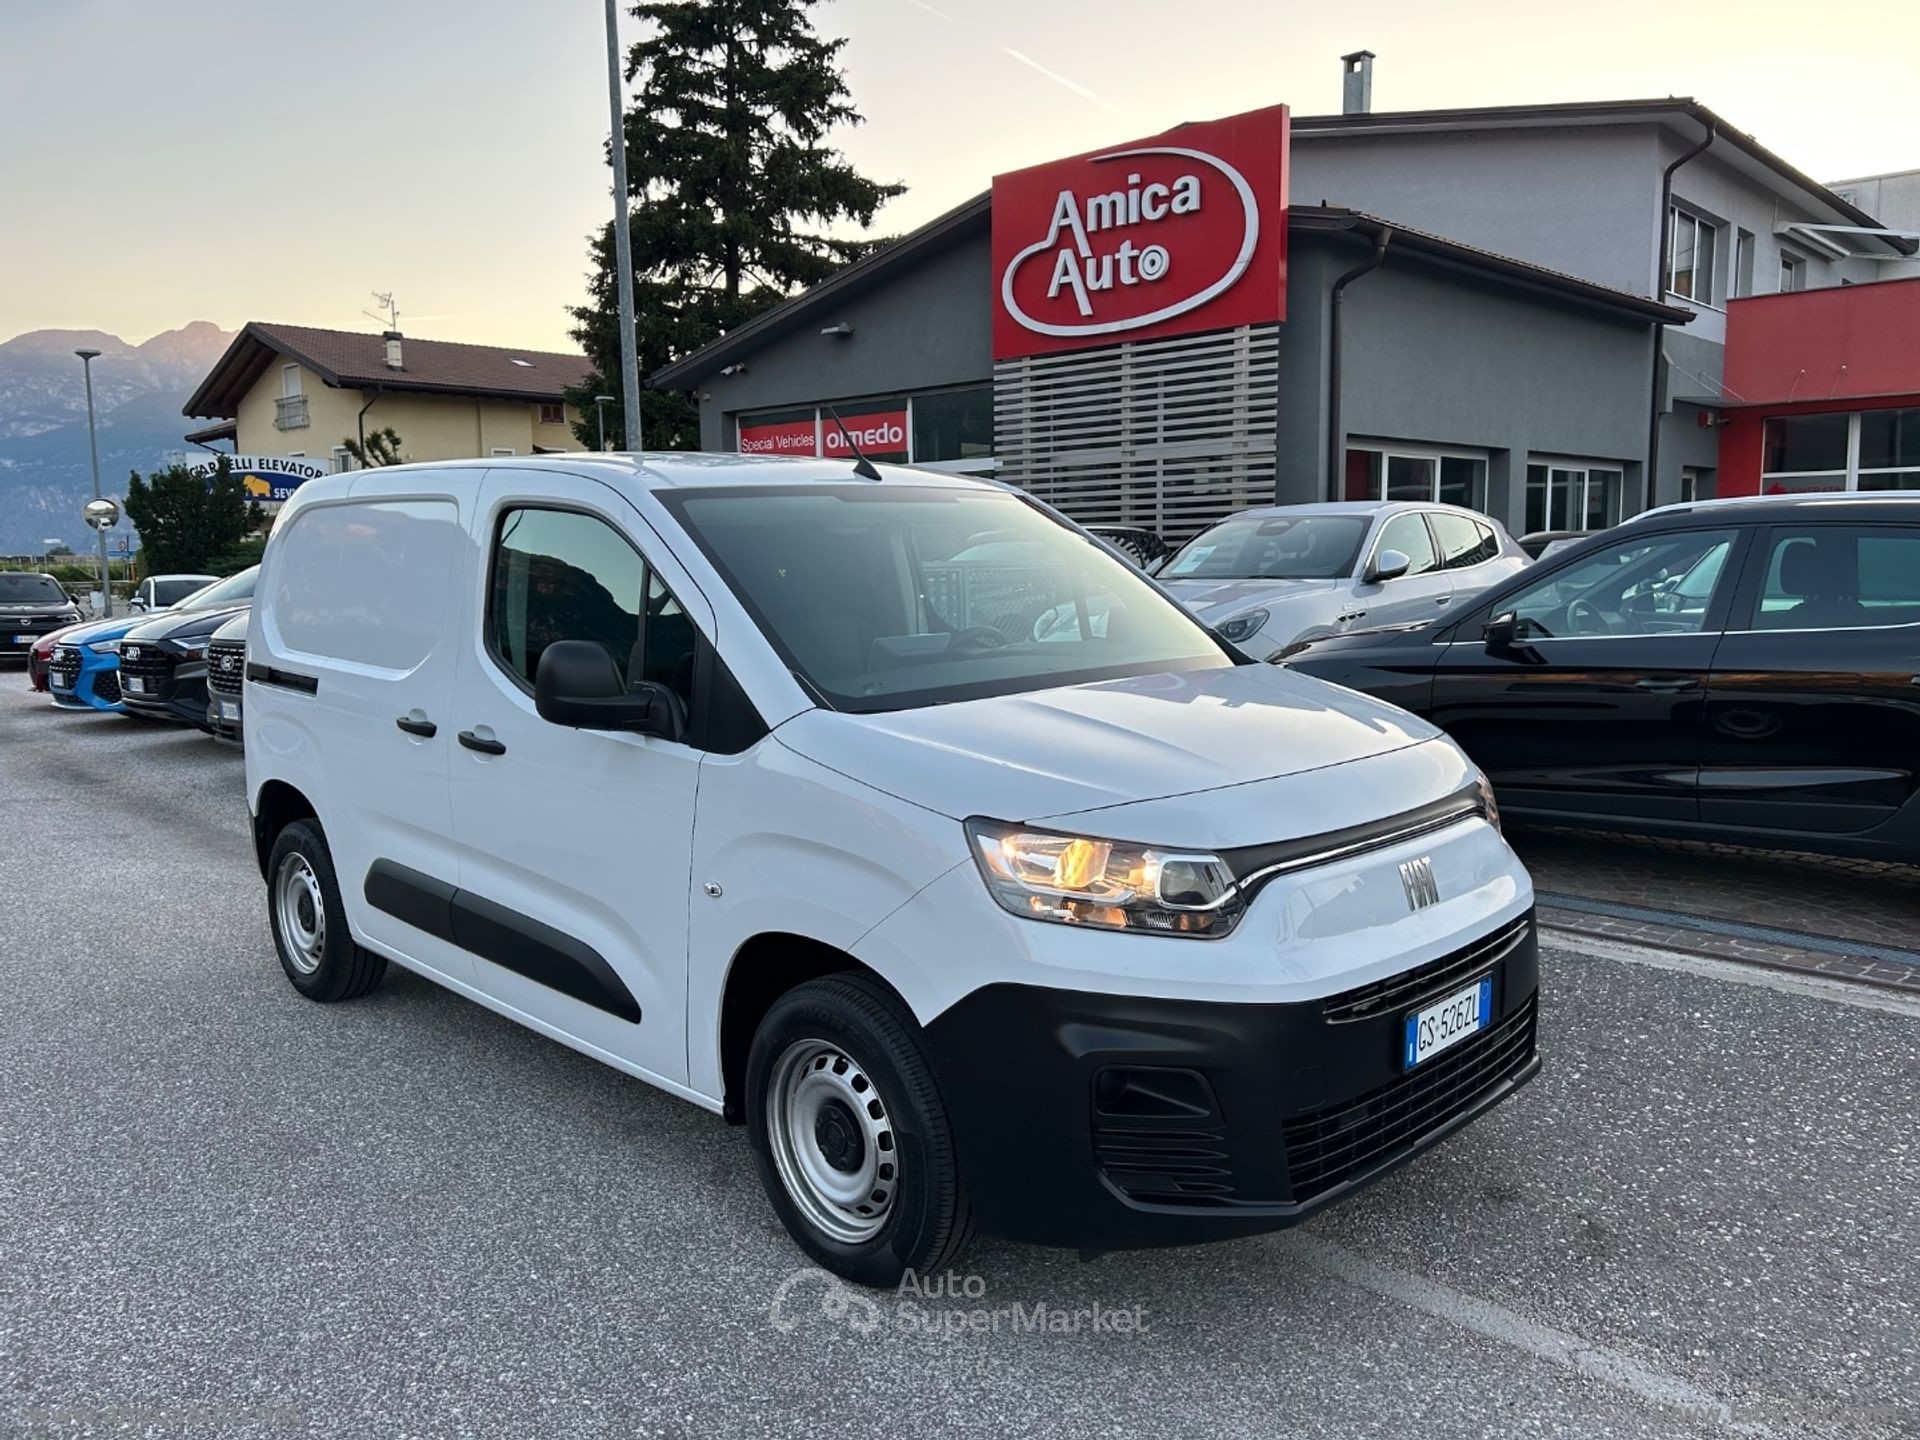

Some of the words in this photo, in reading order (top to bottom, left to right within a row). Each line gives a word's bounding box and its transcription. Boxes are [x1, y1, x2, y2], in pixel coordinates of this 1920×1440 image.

[1045, 173, 1201, 258] Amica
[1047, 240, 1170, 317] Auto
[189, 457, 252, 479] CARELLI
[258, 458, 328, 479] ELEVATOR
[742, 436, 775, 454] Special
[775, 433, 815, 448] Vehicles
[1399, 856, 1439, 911] FIAT
